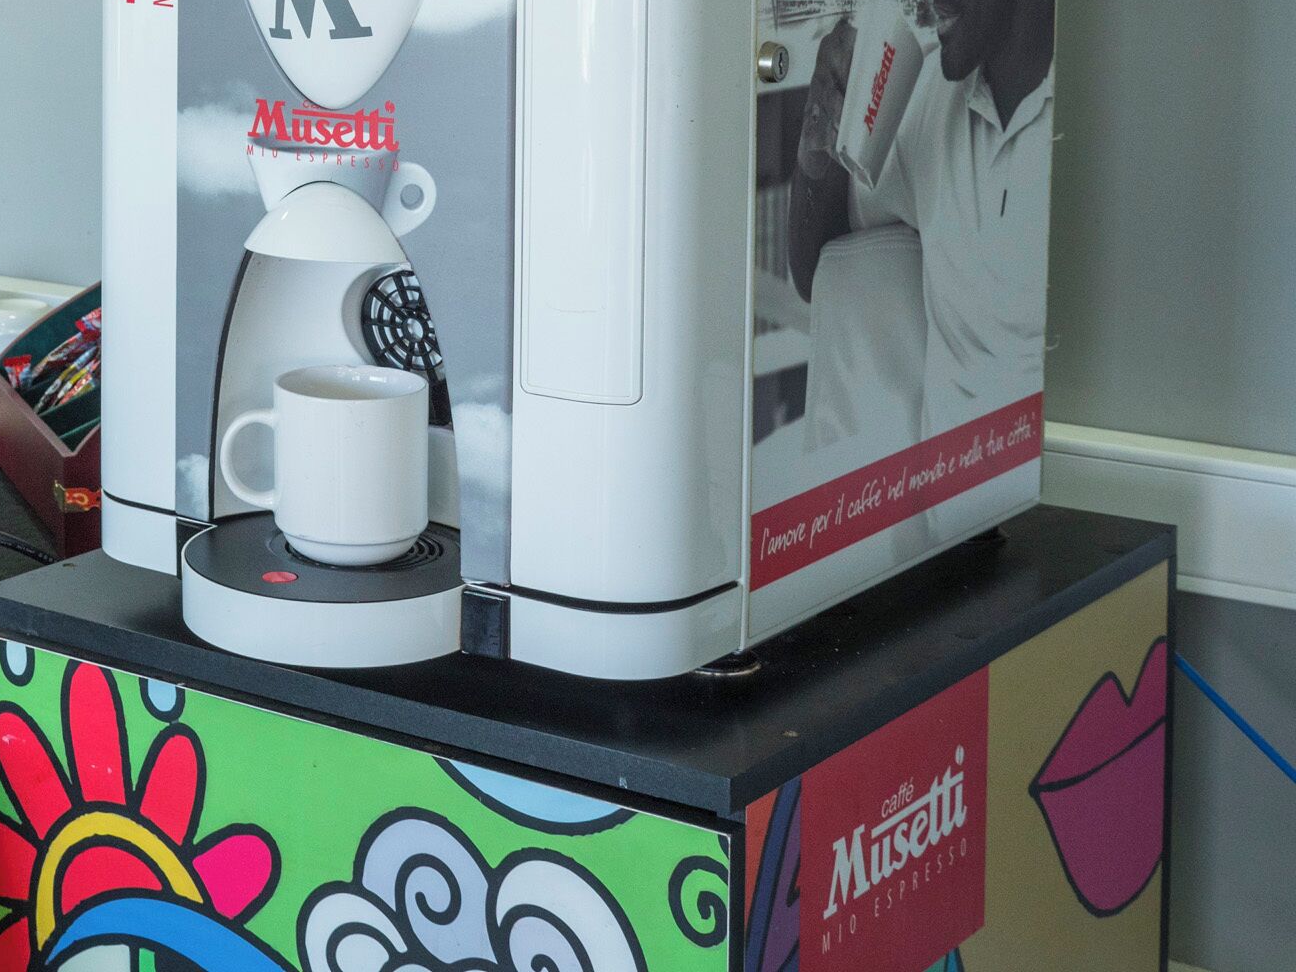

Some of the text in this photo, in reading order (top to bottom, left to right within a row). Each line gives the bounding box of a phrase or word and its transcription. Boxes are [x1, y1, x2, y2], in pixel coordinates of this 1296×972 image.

[247, 99, 399, 152] Musetti
[864, 41, 896, 137] Musetti
[246, 145, 400, 172] MIO ESPRESSO
[809, 509, 832, 549] per
[835, 493, 845, 525] il
[887, 466, 907, 501] nel
[909, 452, 946, 491] mondo
[948, 456, 956, 474] e
[986, 428, 1004, 457] tua
[823, 744, 968, 920] Musetti
[822, 837, 967, 955] MIO ESPRESSO
